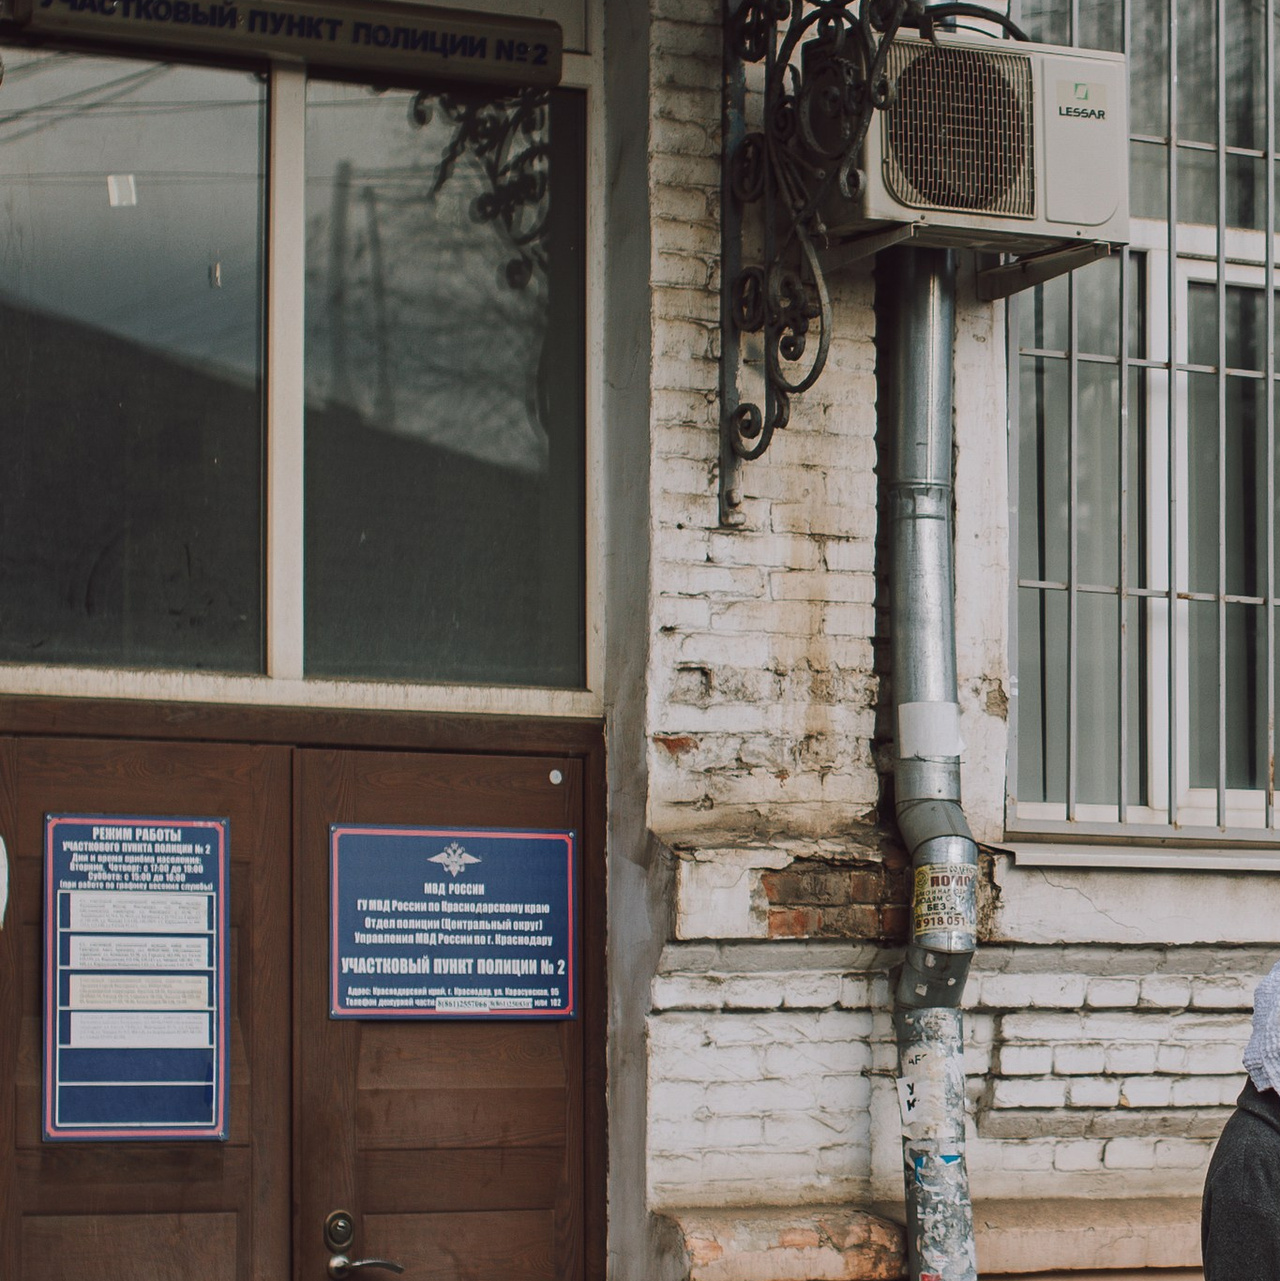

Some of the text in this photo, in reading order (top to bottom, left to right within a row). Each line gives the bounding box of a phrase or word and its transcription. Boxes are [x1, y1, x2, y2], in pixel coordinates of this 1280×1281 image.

[248, 9, 341, 42] ПУНКТ
[352, 22, 488, 60] ПОЛИЦИИ
[1059, 106, 1106, 120] LESSAR
[92, 827, 182, 842] РЕЖИМ РАБОТЫ
[62, 841, 120, 853] УЧАСТКОВОГО
[122, 842, 153, 853] ПУНКТА
[154, 843, 193, 855] ПОЛИЦИИ
[71, 853, 89, 863] Дни
[90, 854, 96, 862] и
[97, 855, 124, 863] время
[170, 865, 182, 873] до
[152, 873, 164, 882] до
[424, 883, 485, 896] МВД РОССИИ
[357, 900, 550, 915] ГУ МВД России по Краснодарскому краю
[927, 903, 946, 911] БЕЗ
[364, 917, 543, 932] Отдел полиции (Центральный округ)
[923, 916, 944, 927] 918
[354, 932, 553, 946] Управления МВД России по г. Краснодару
[341, 955, 430, 974] УЧАСТКОВЫЙ
[433, 958, 474, 974] ПУНКТ
[477, 959, 537, 976] ПОЛИЦИИ
[557, 959, 565, 975] 2
[345, 997, 377, 1006] Телефон
[550, 998, 562, 1007] 102
